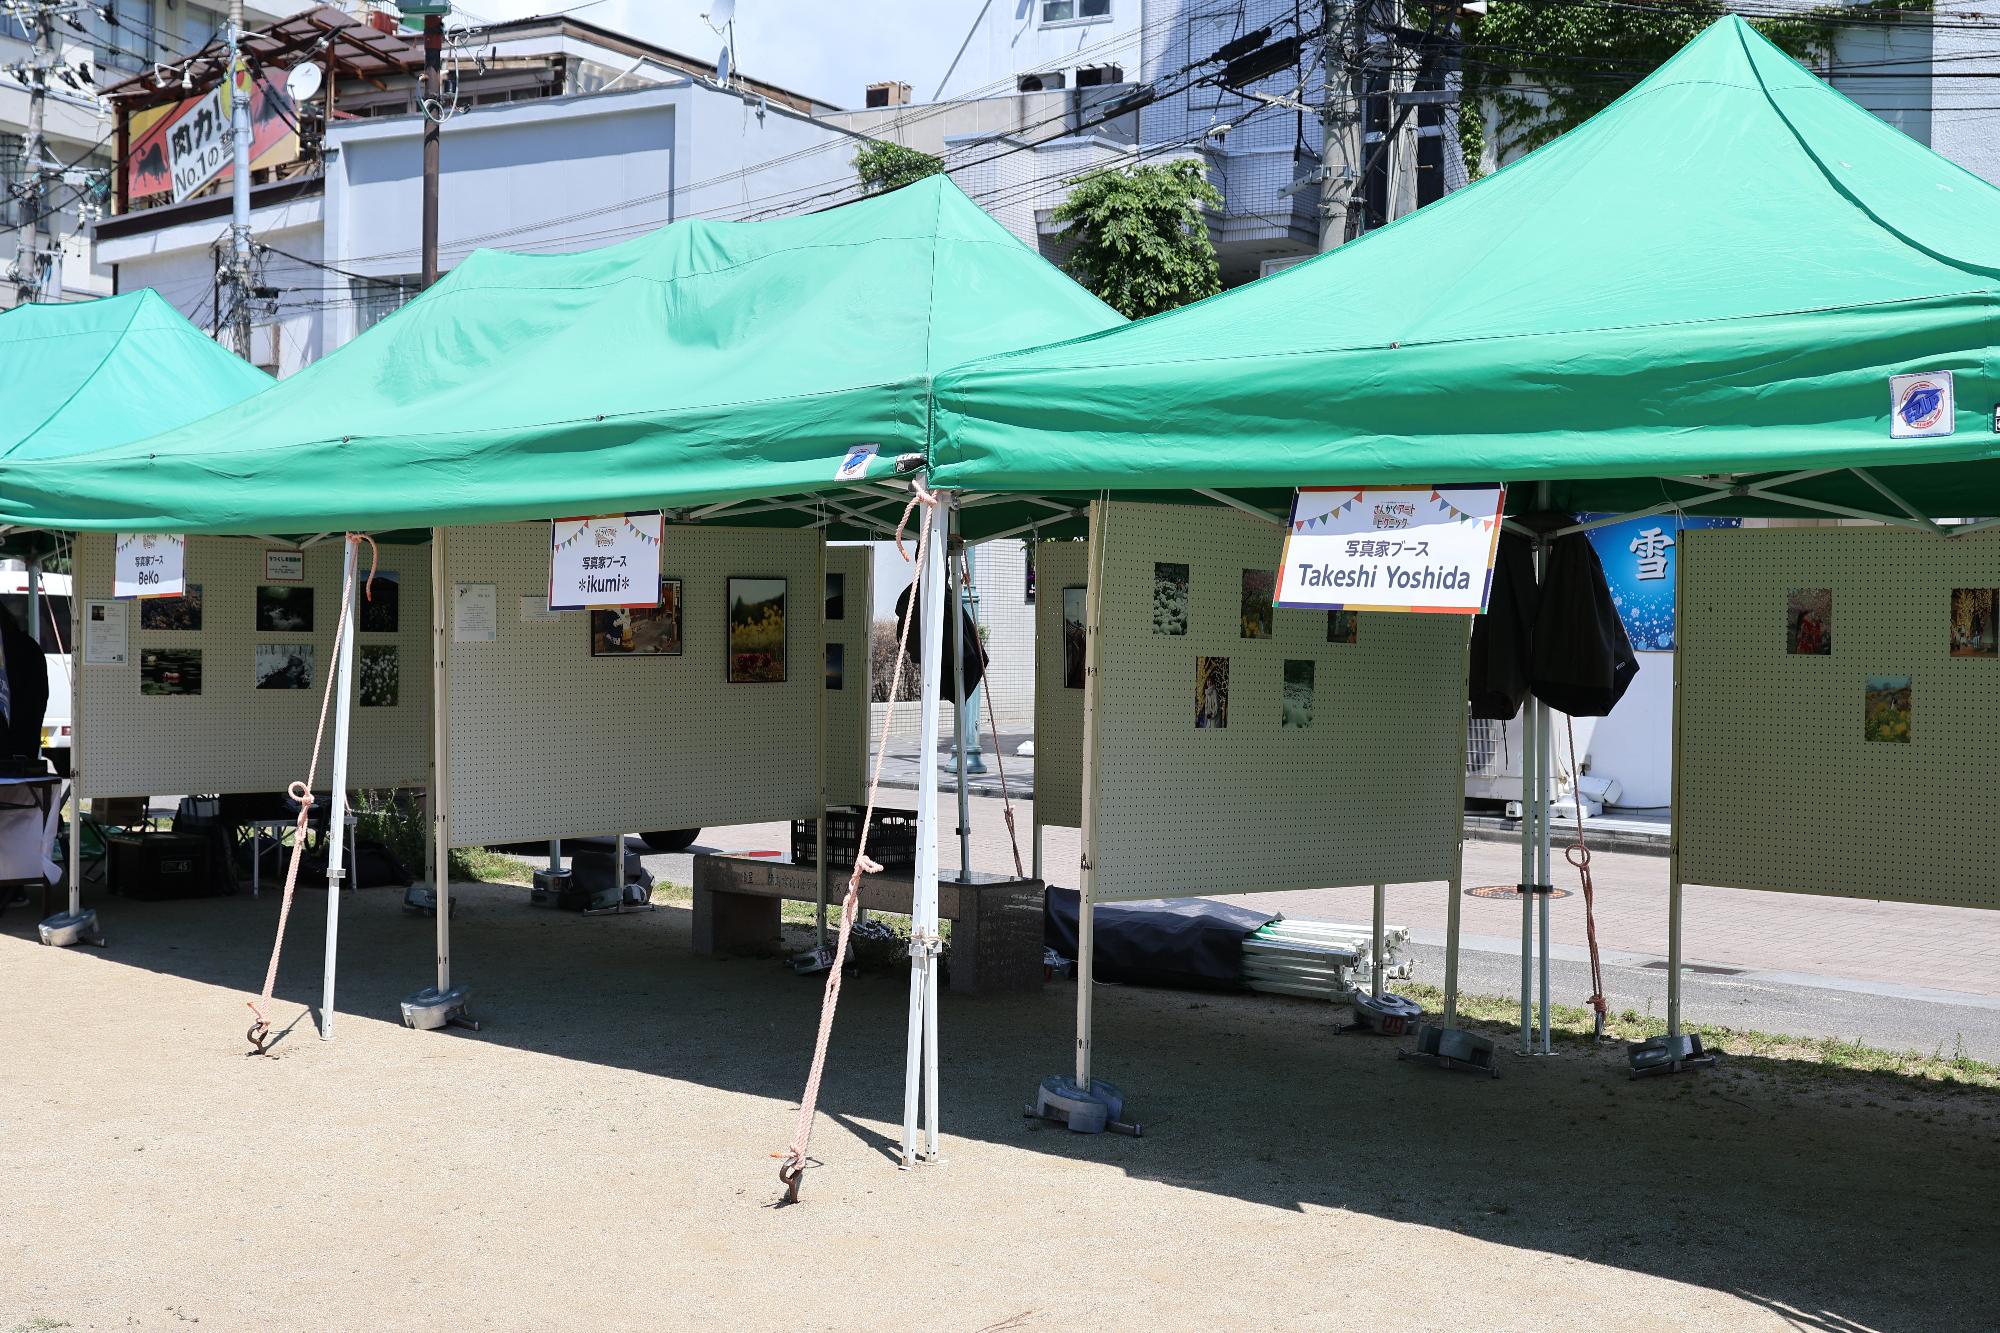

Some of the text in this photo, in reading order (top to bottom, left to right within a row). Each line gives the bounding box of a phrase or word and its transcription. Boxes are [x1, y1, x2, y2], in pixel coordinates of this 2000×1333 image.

[1345, 540, 1429, 558] 写真家ブース
[1629, 527, 1676, 581] 雪
[582, 555, 627, 570] 写真家ブース
[138, 570, 160, 586] BeKo
[1298, 563, 1471, 590] Takeshi Yoshida
